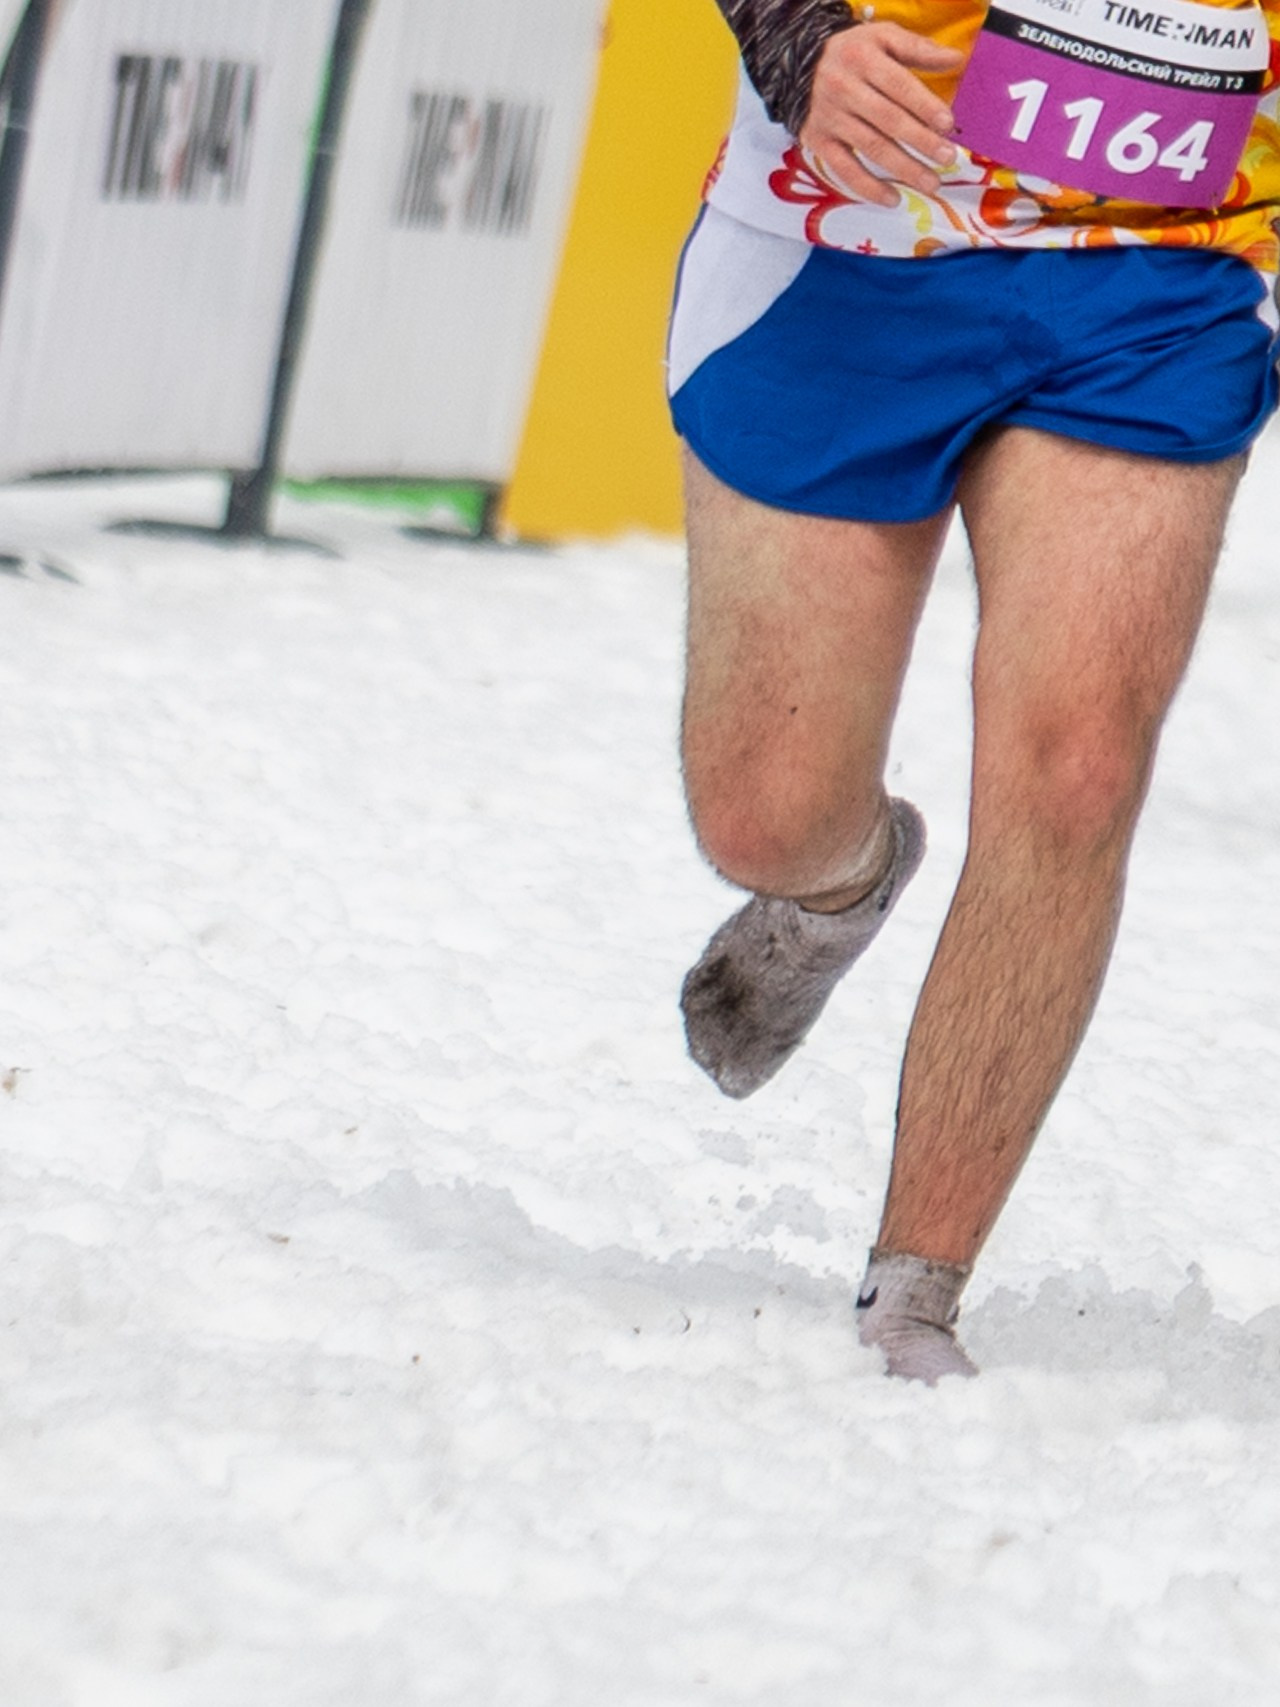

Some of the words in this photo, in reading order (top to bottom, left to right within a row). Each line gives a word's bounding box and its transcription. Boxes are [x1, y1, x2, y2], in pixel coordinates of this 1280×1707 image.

[1017, 23, 1172, 80] ЗЕЛЕНОДОЛЬСКИЙ
[1173, 69, 1221, 88] ТРЕЙЛ
[1008, 79, 1215, 181] 1164
